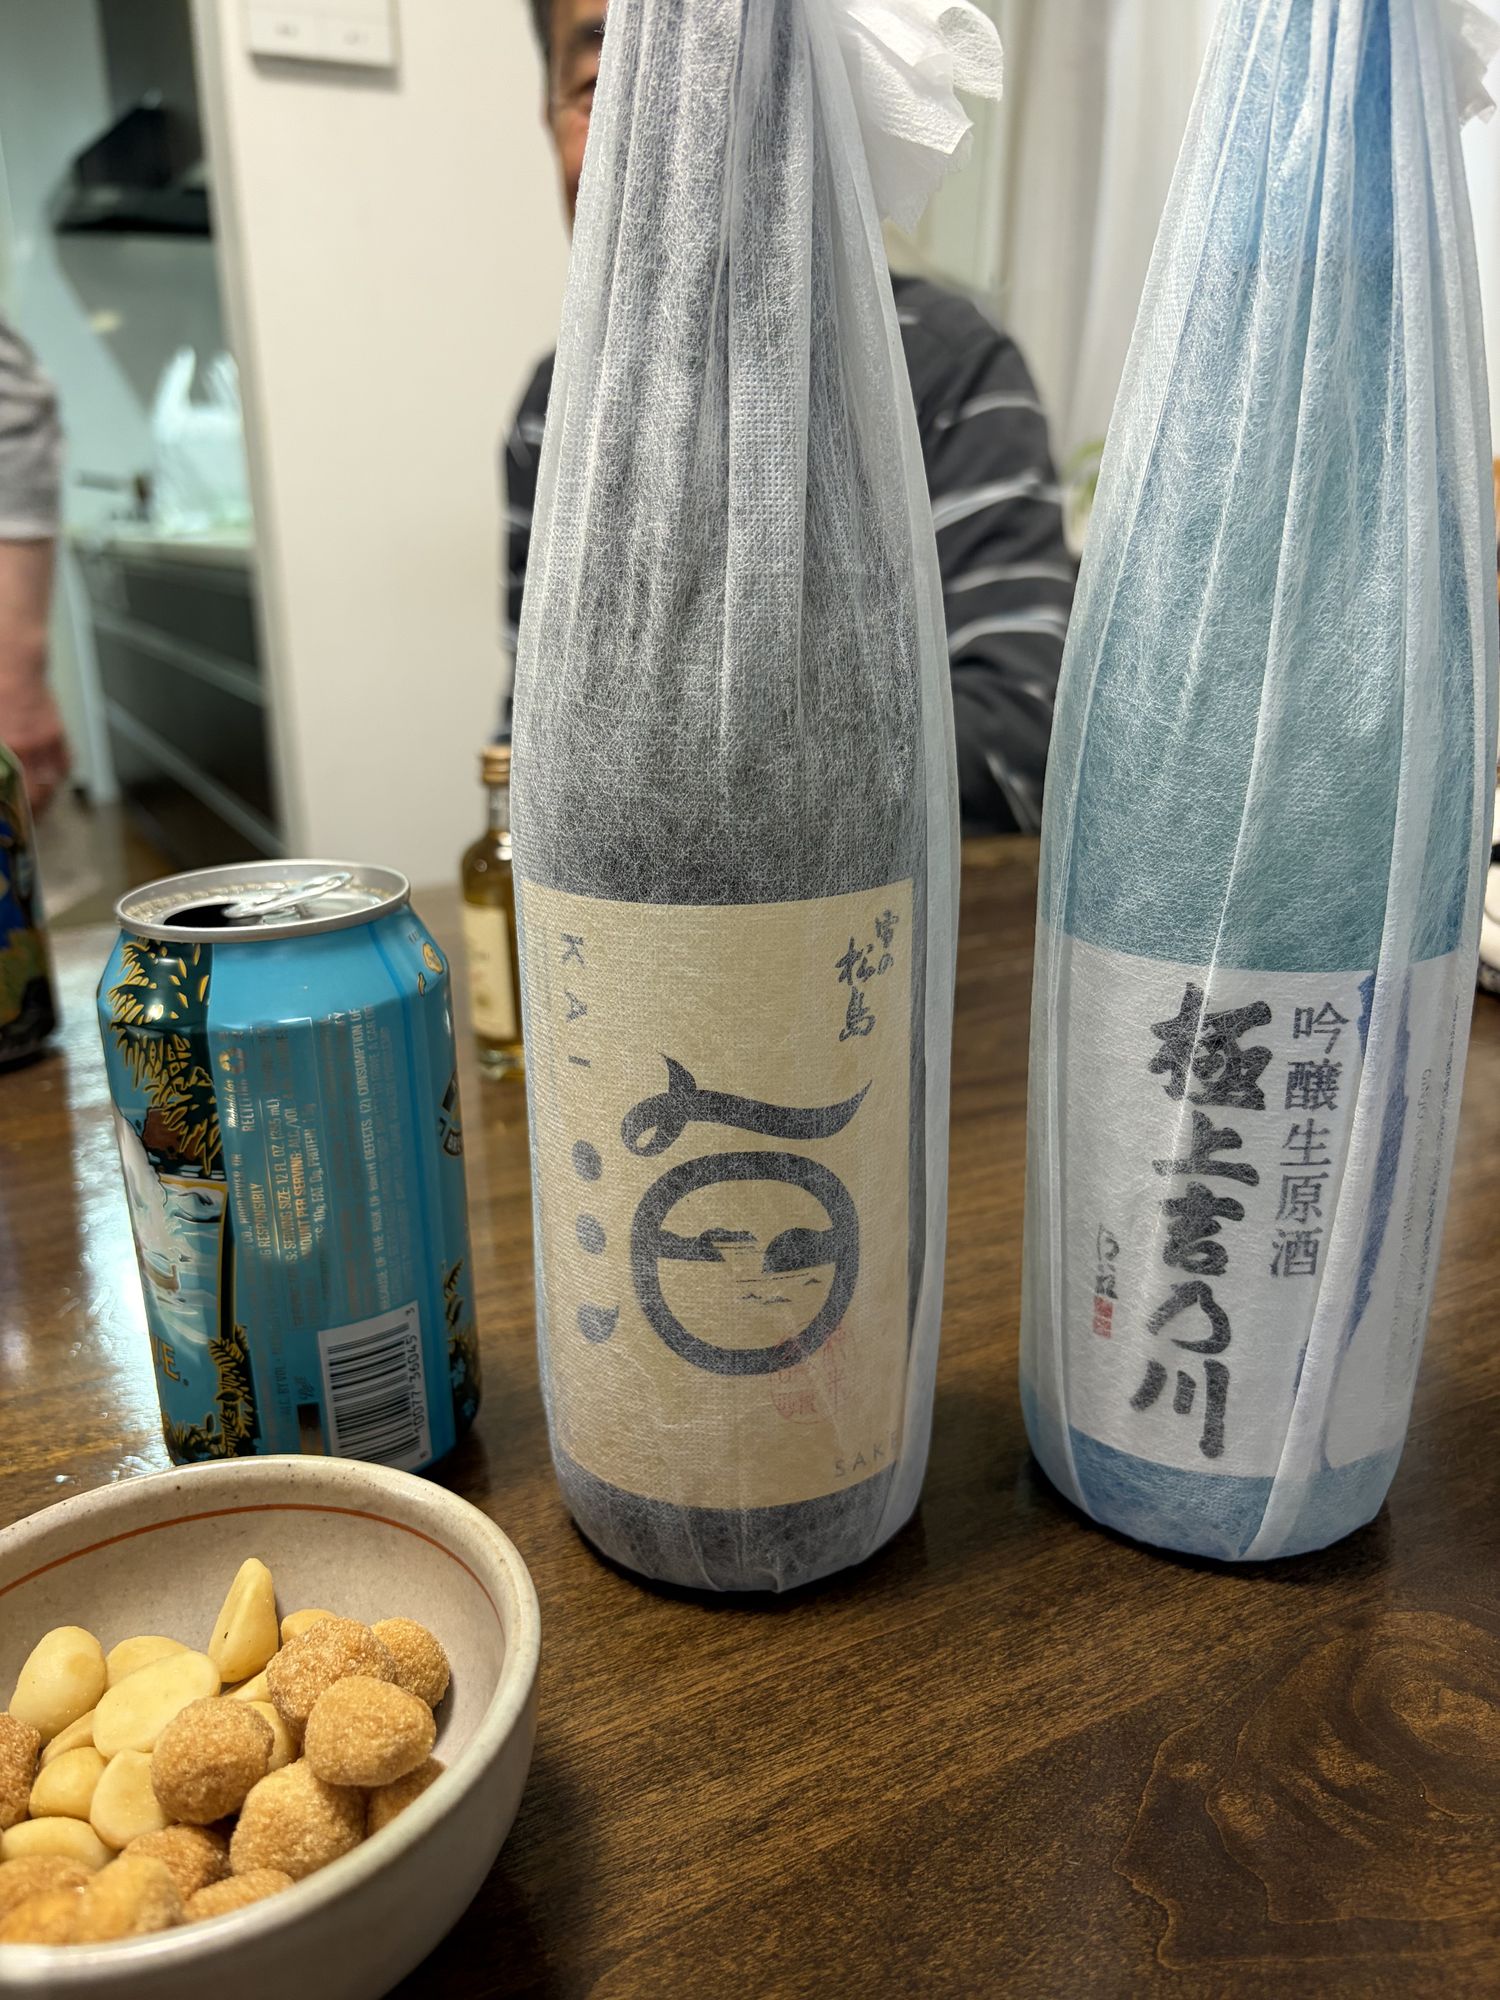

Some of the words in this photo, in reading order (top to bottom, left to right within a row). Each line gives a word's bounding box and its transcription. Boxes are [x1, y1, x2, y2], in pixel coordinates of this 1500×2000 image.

[347, 1007, 361, 1022] OF
[560, 932, 591, 1068] KAI
[351, 1024, 370, 1096] CONSUMPTION
[359, 1098, 373, 1114] (2)
[1269, 1001, 1349, 1279] 吟醸生原酒
[275, 1172, 288, 1184] 12
[249, 1183, 272, 1248] RESPONSIBLY
[404, 1334, 422, 1383] 36045
[408, 1391, 427, 1434] 10077
